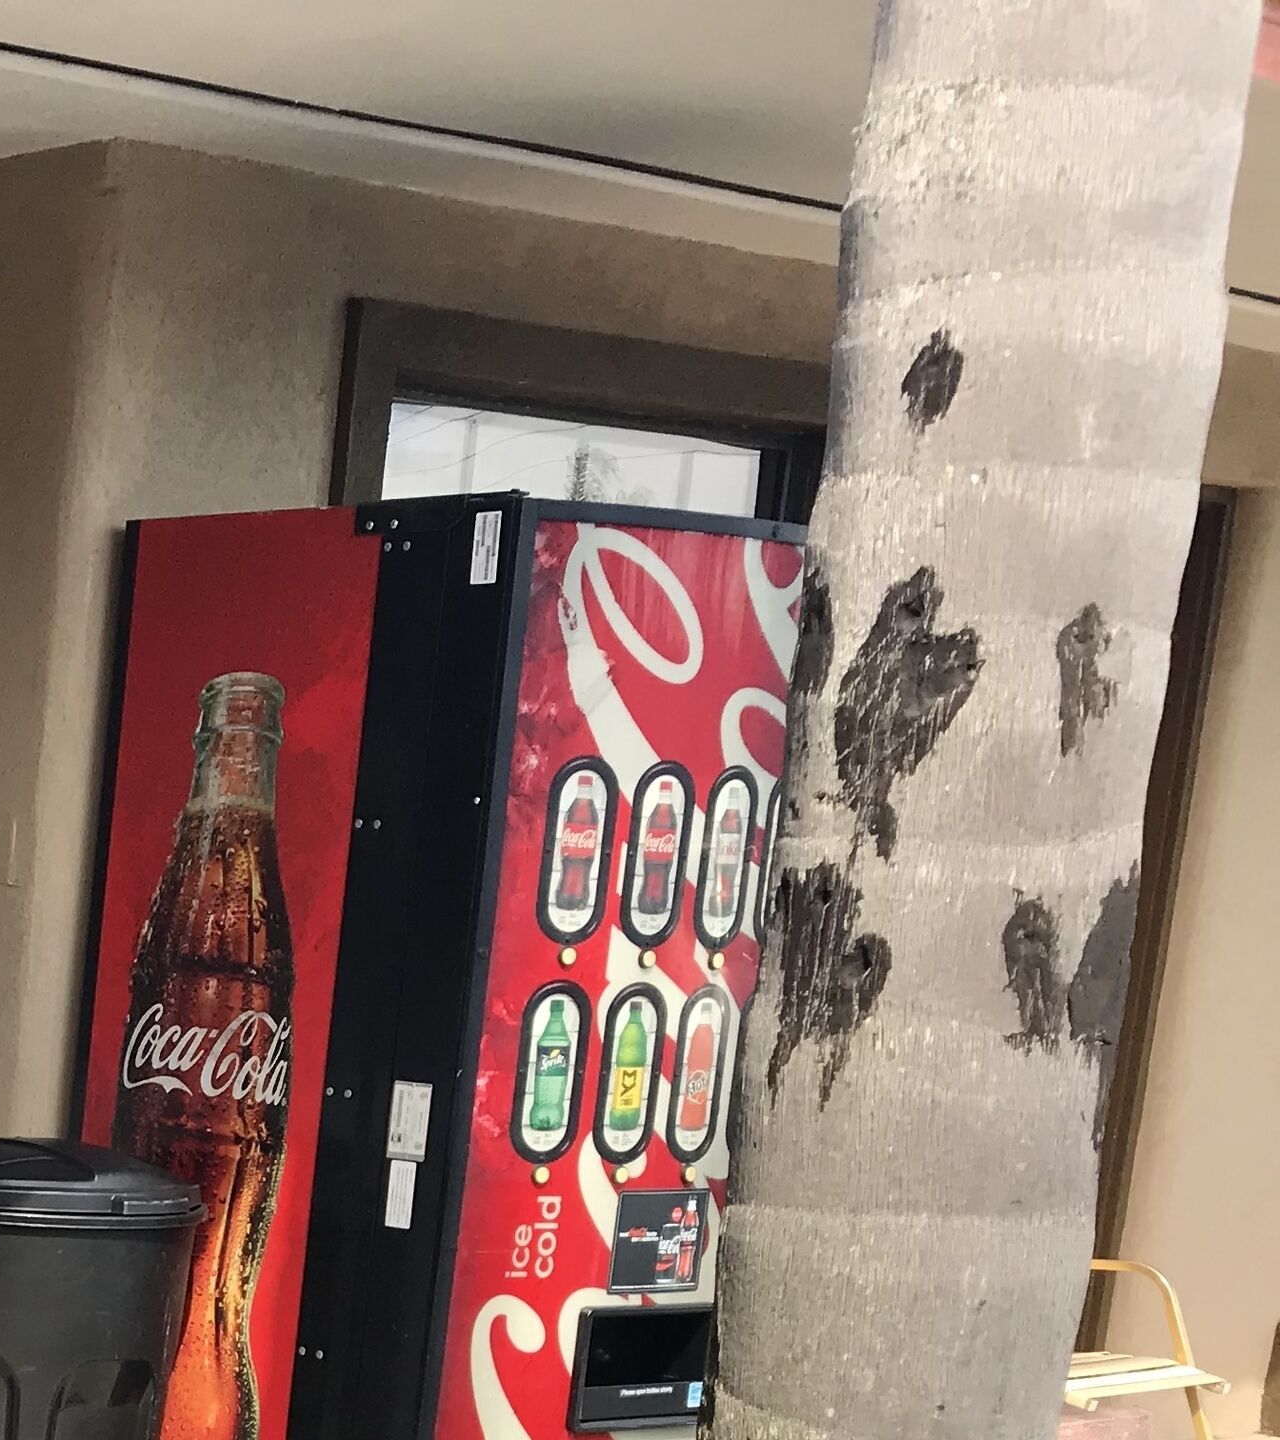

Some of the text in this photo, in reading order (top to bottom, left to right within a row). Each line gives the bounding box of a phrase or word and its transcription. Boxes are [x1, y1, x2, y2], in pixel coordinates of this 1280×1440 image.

[123, 1003, 291, 1106] Coca-Cola
[505, 1224, 533, 1278] ice
[534, 1195, 562, 1278] cold
